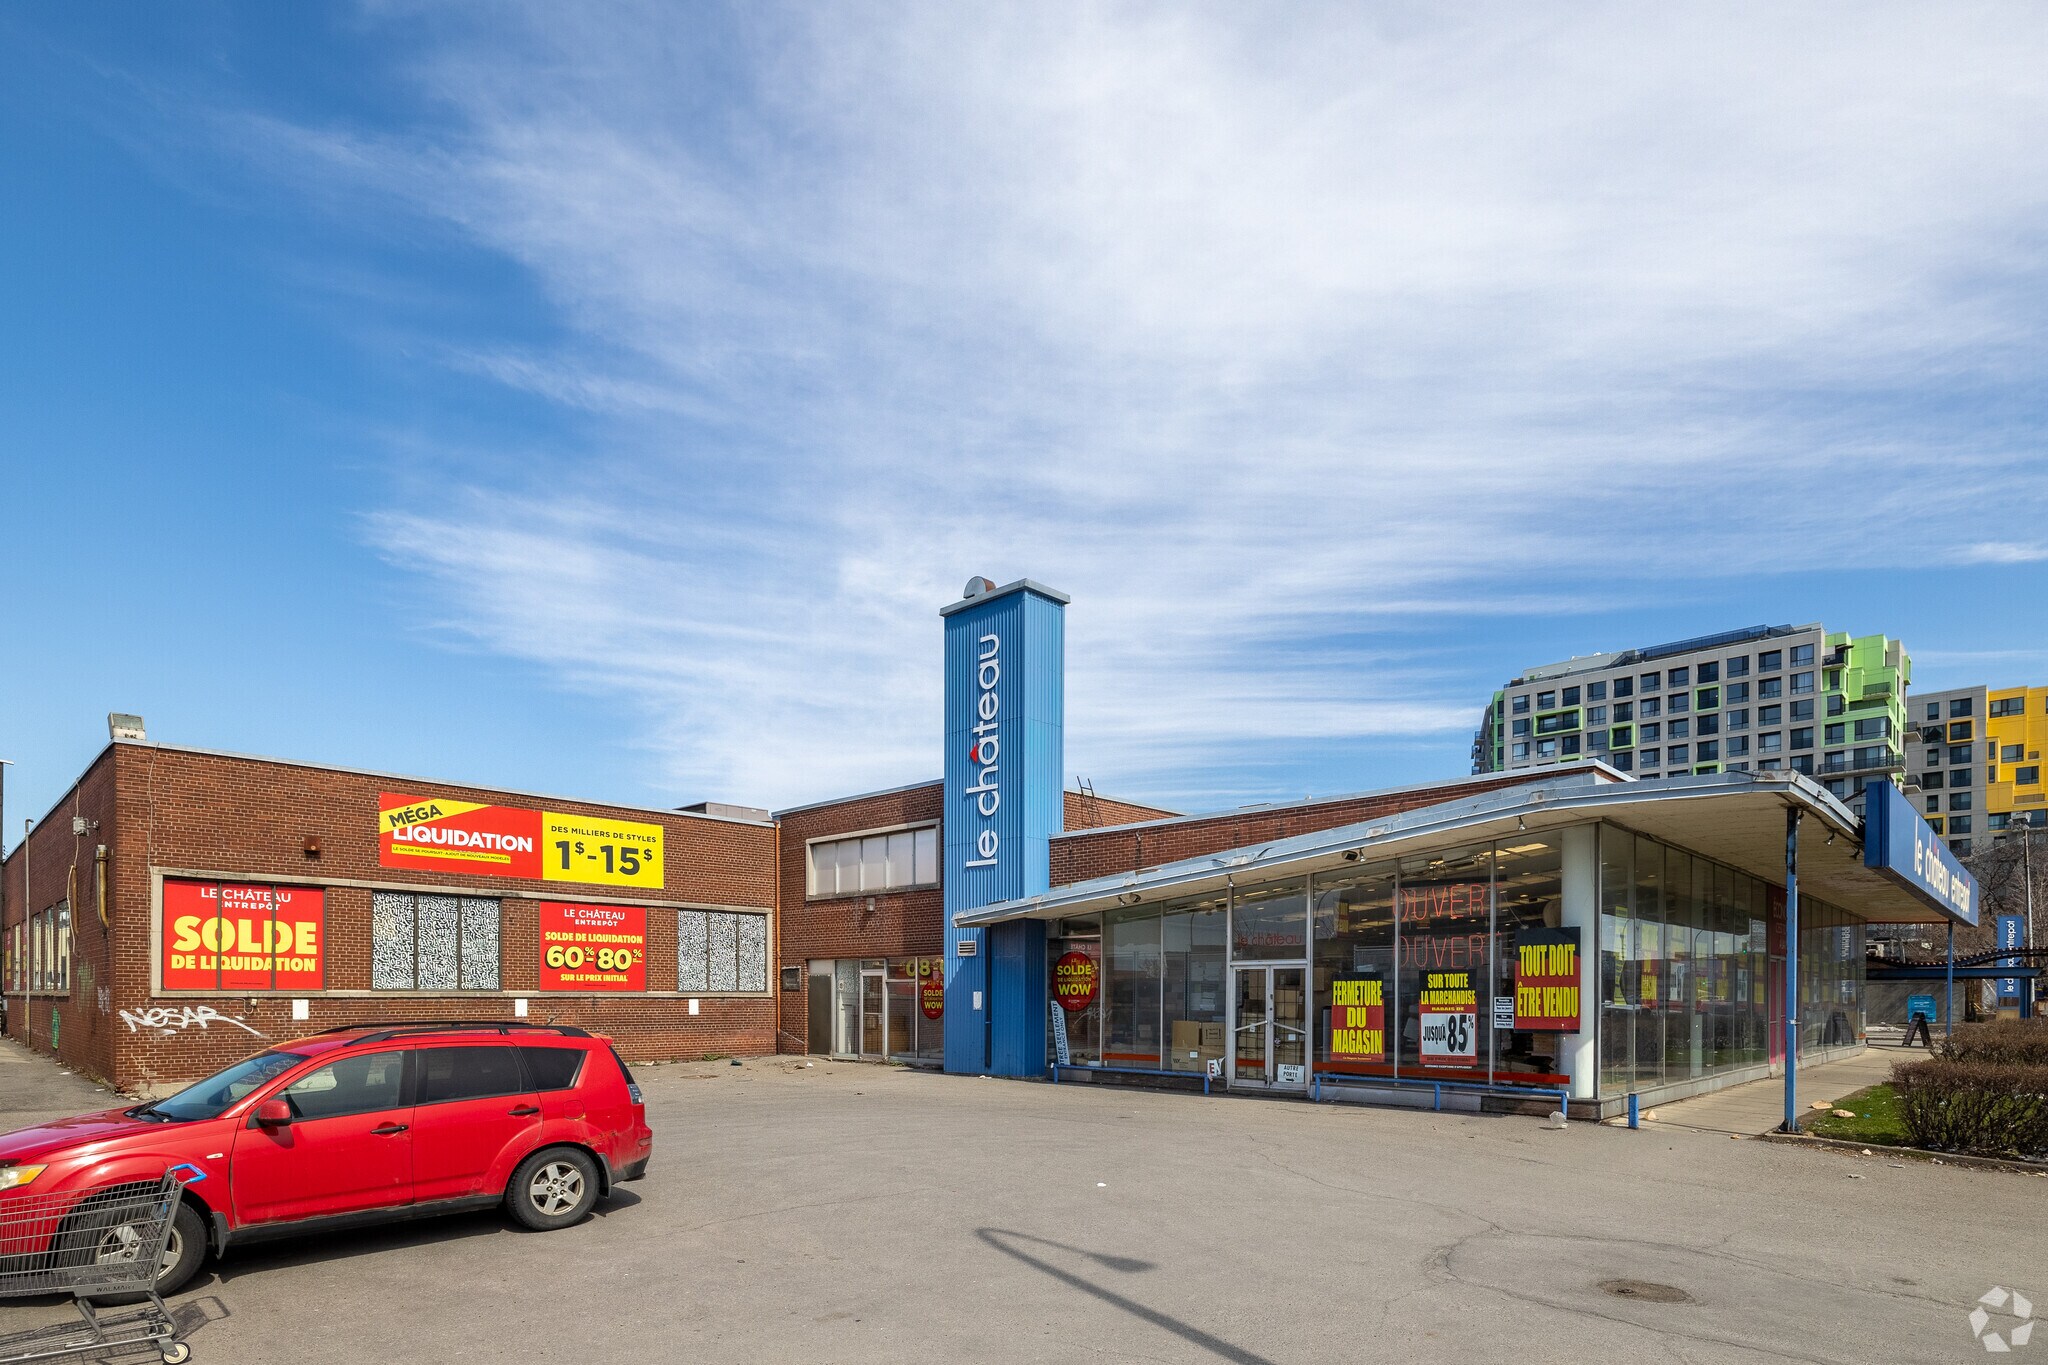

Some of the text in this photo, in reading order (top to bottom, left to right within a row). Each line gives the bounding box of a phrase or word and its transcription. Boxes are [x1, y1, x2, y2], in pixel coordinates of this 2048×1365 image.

[966, 634, 1000, 867] le château
[388, 804, 443, 827] MÉGA
[393, 825, 533, 852] LIQUIDATION
[571, 828, 610, 838] MILLIERS
[626, 834, 656, 842] STYLES
[1914, 815, 1922, 876] le
[201, 888, 291, 902] LE CHÂTEAU
[222, 901, 280, 910] NTREPÔT
[1392, 883, 1501, 920] OUVER
[564, 909, 625, 920] LE CHÂTEAU
[172, 915, 317, 954] SOLDE
[545, 932, 642, 944] SOLDE DE LIQUIDATION
[171, 955, 316, 972] DE LIQUIDATION
[1057, 965, 1091, 975] SOLDE
[1519, 944, 1575, 977] TOUT DOIT
[585, 974, 602, 982] PRIX
[1428, 973, 1468, 989] SUR TOUTE
[1058, 984, 1091, 995] WOW
[1333, 981, 1382, 1006] FERMETURE
[1421, 990, 1476, 1005] LA MARCHANDISE
[1517, 981, 1578, 1017] ÊTRE VENDU
[1052, 1002, 1062, 1045] SEULEMENT
[1347, 1007, 1366, 1028] DU
[1333, 1029, 1382, 1054] MAGASIN
